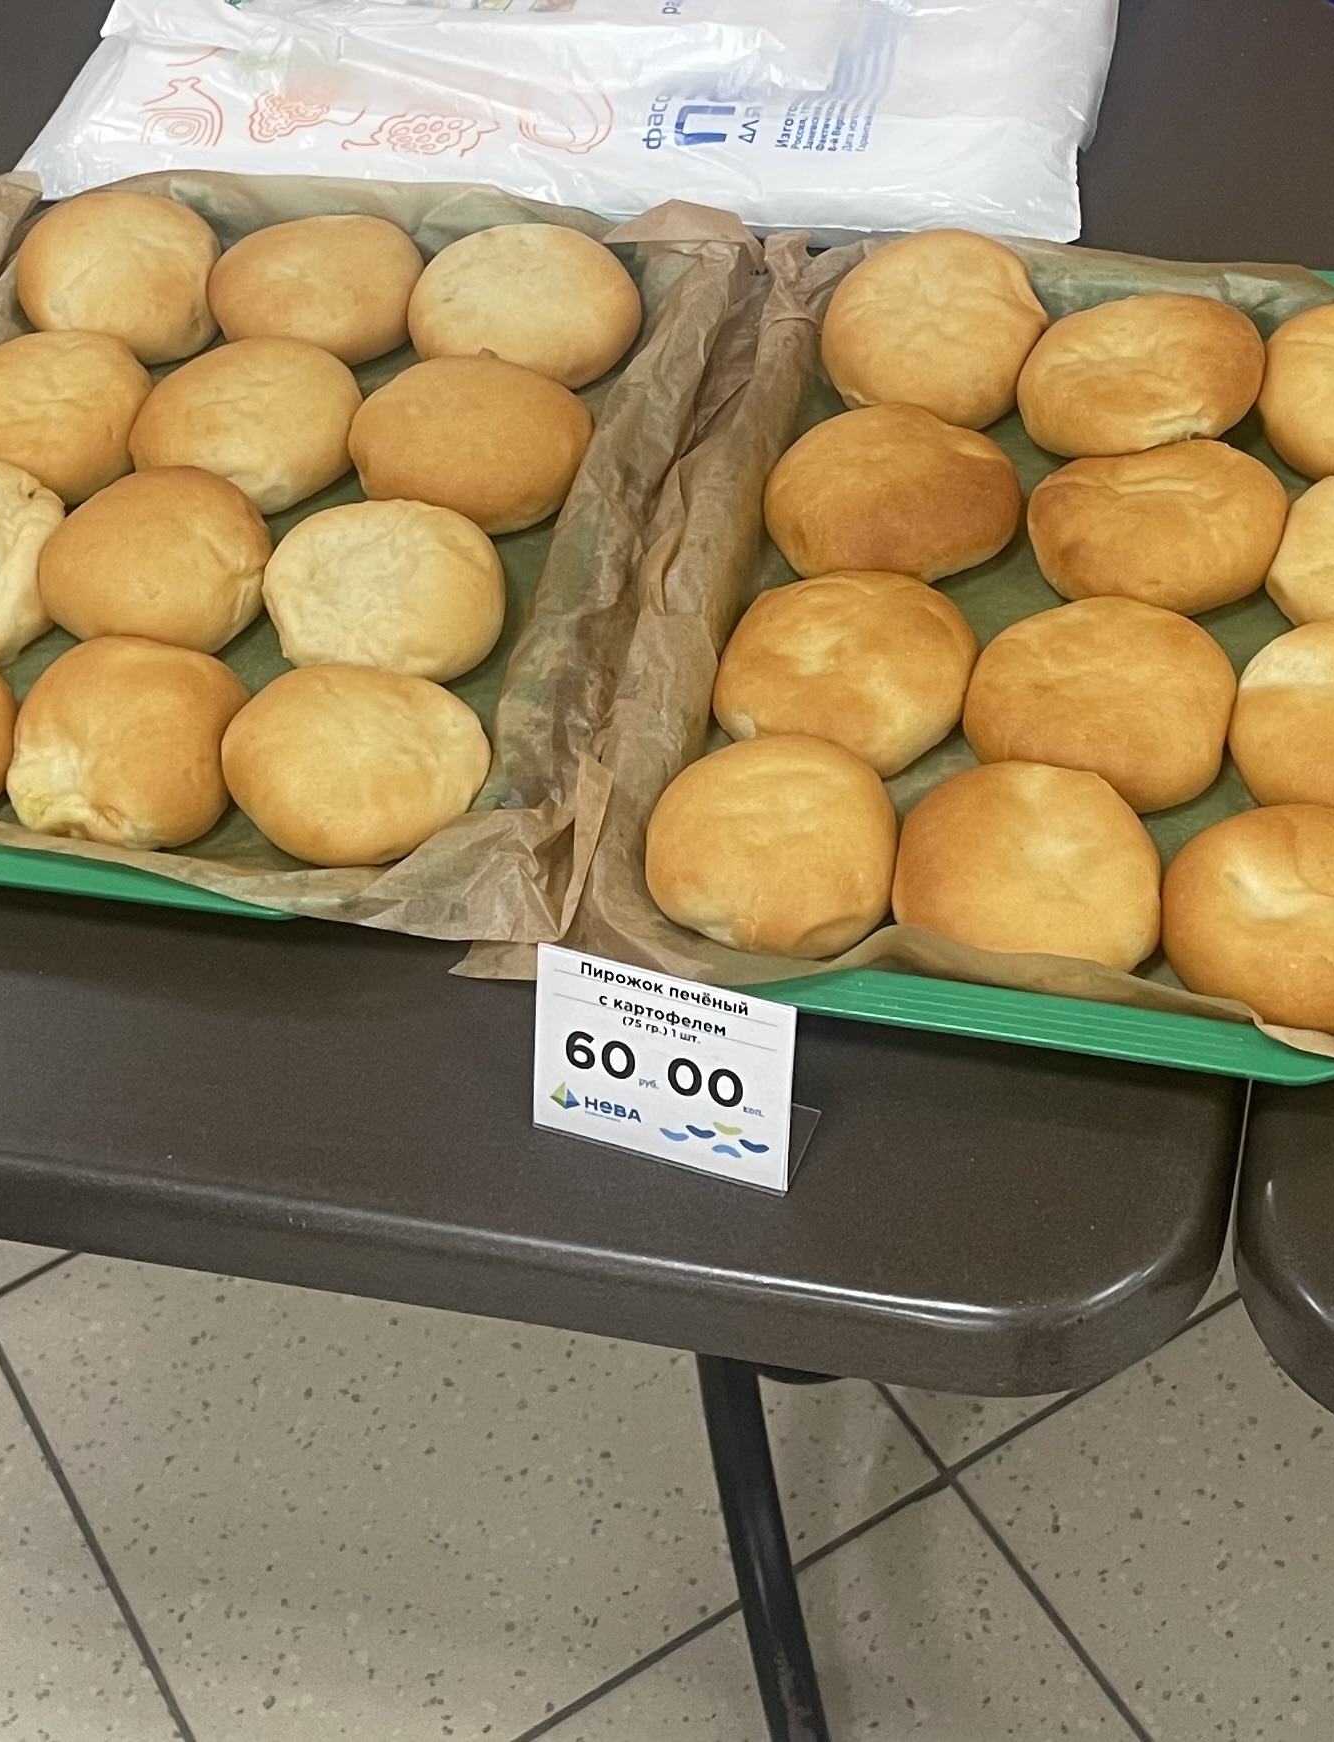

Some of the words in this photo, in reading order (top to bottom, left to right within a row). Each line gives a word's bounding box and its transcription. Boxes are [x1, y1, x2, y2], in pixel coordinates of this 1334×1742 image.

[580, 961, 664, 995] Пирожок
[669, 987, 748, 1016] печёный
[598, 995, 608, 1006] с
[614, 999, 726, 1036] картофелем
[622, 1016, 642, 1028] (75
[646, 1023, 668, 1036] гр.)
[671, 1028, 677, 1038] 1
[680, 1032, 701, 1045] шт.
[565, 1031, 636, 1080] 60
[667, 1058, 744, 1108] 00
